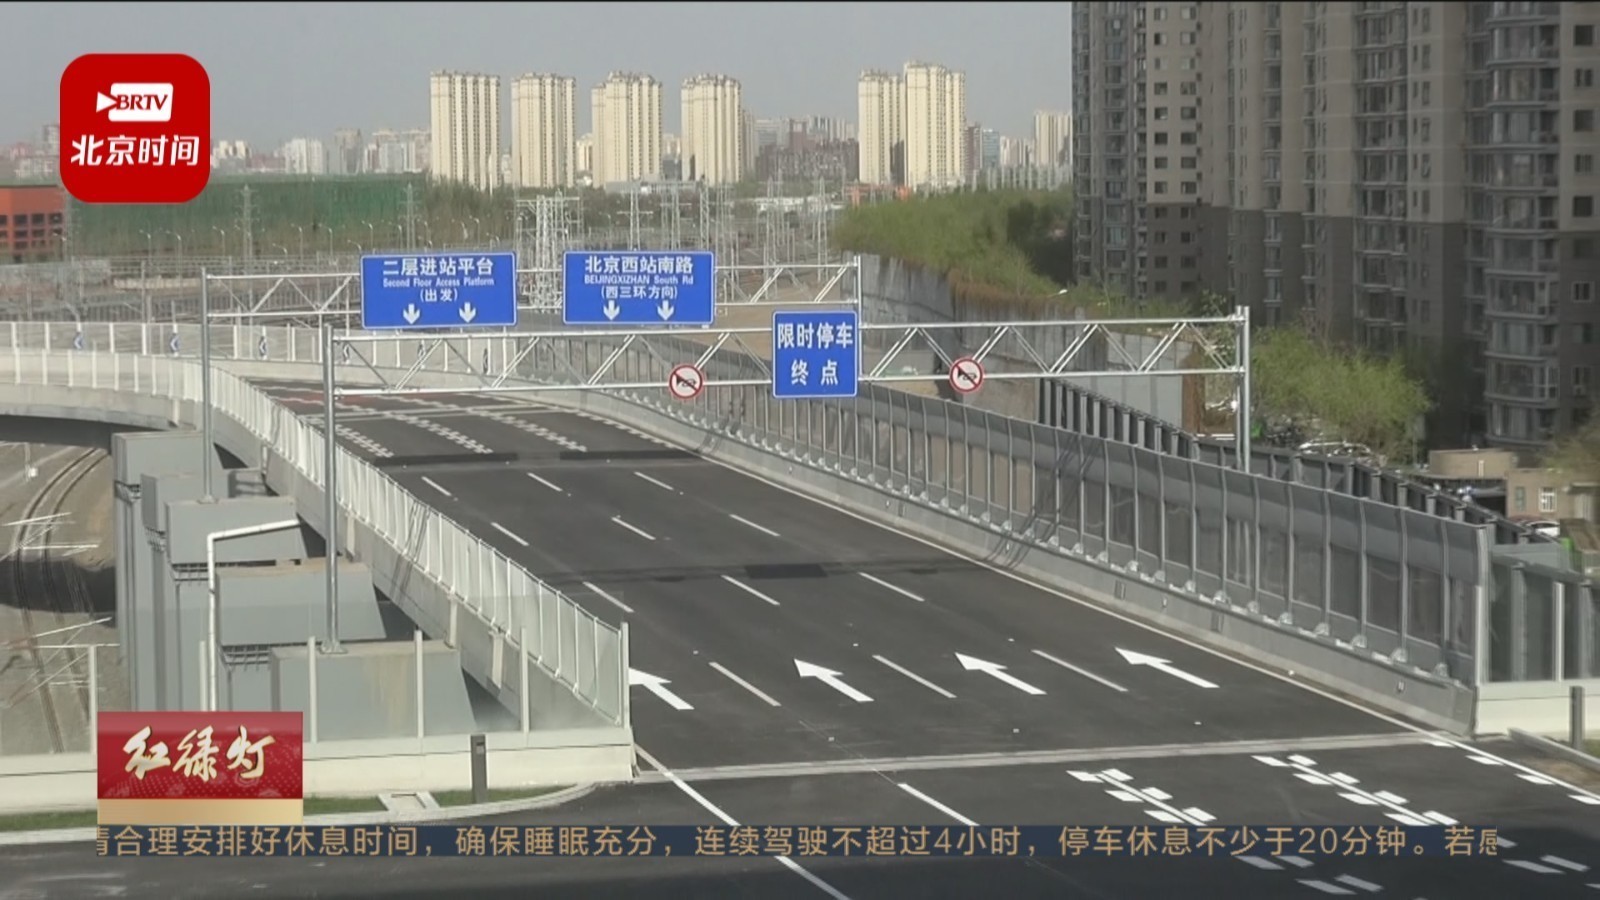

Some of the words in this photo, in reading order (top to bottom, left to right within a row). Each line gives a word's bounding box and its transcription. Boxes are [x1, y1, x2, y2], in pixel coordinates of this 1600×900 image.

[383, 257, 493, 276] 二层进站平台
[585, 255, 693, 274] 北京西站南路
[383, 278, 410, 288] Second
[413, 278, 432, 287] Floor
[436, 277, 460, 287] Access
[464, 276, 495, 286] Platform
[584, 274, 650, 285] BEIJINGXIZHAN
[654, 274, 678, 285] South
[682, 274, 694, 285] Rd
[420, 288, 458, 302] (出发)
[601, 285, 678, 300] (西三环方向)
[777, 322, 853, 348] 限时停车
[791, 360, 839, 385] 终点
